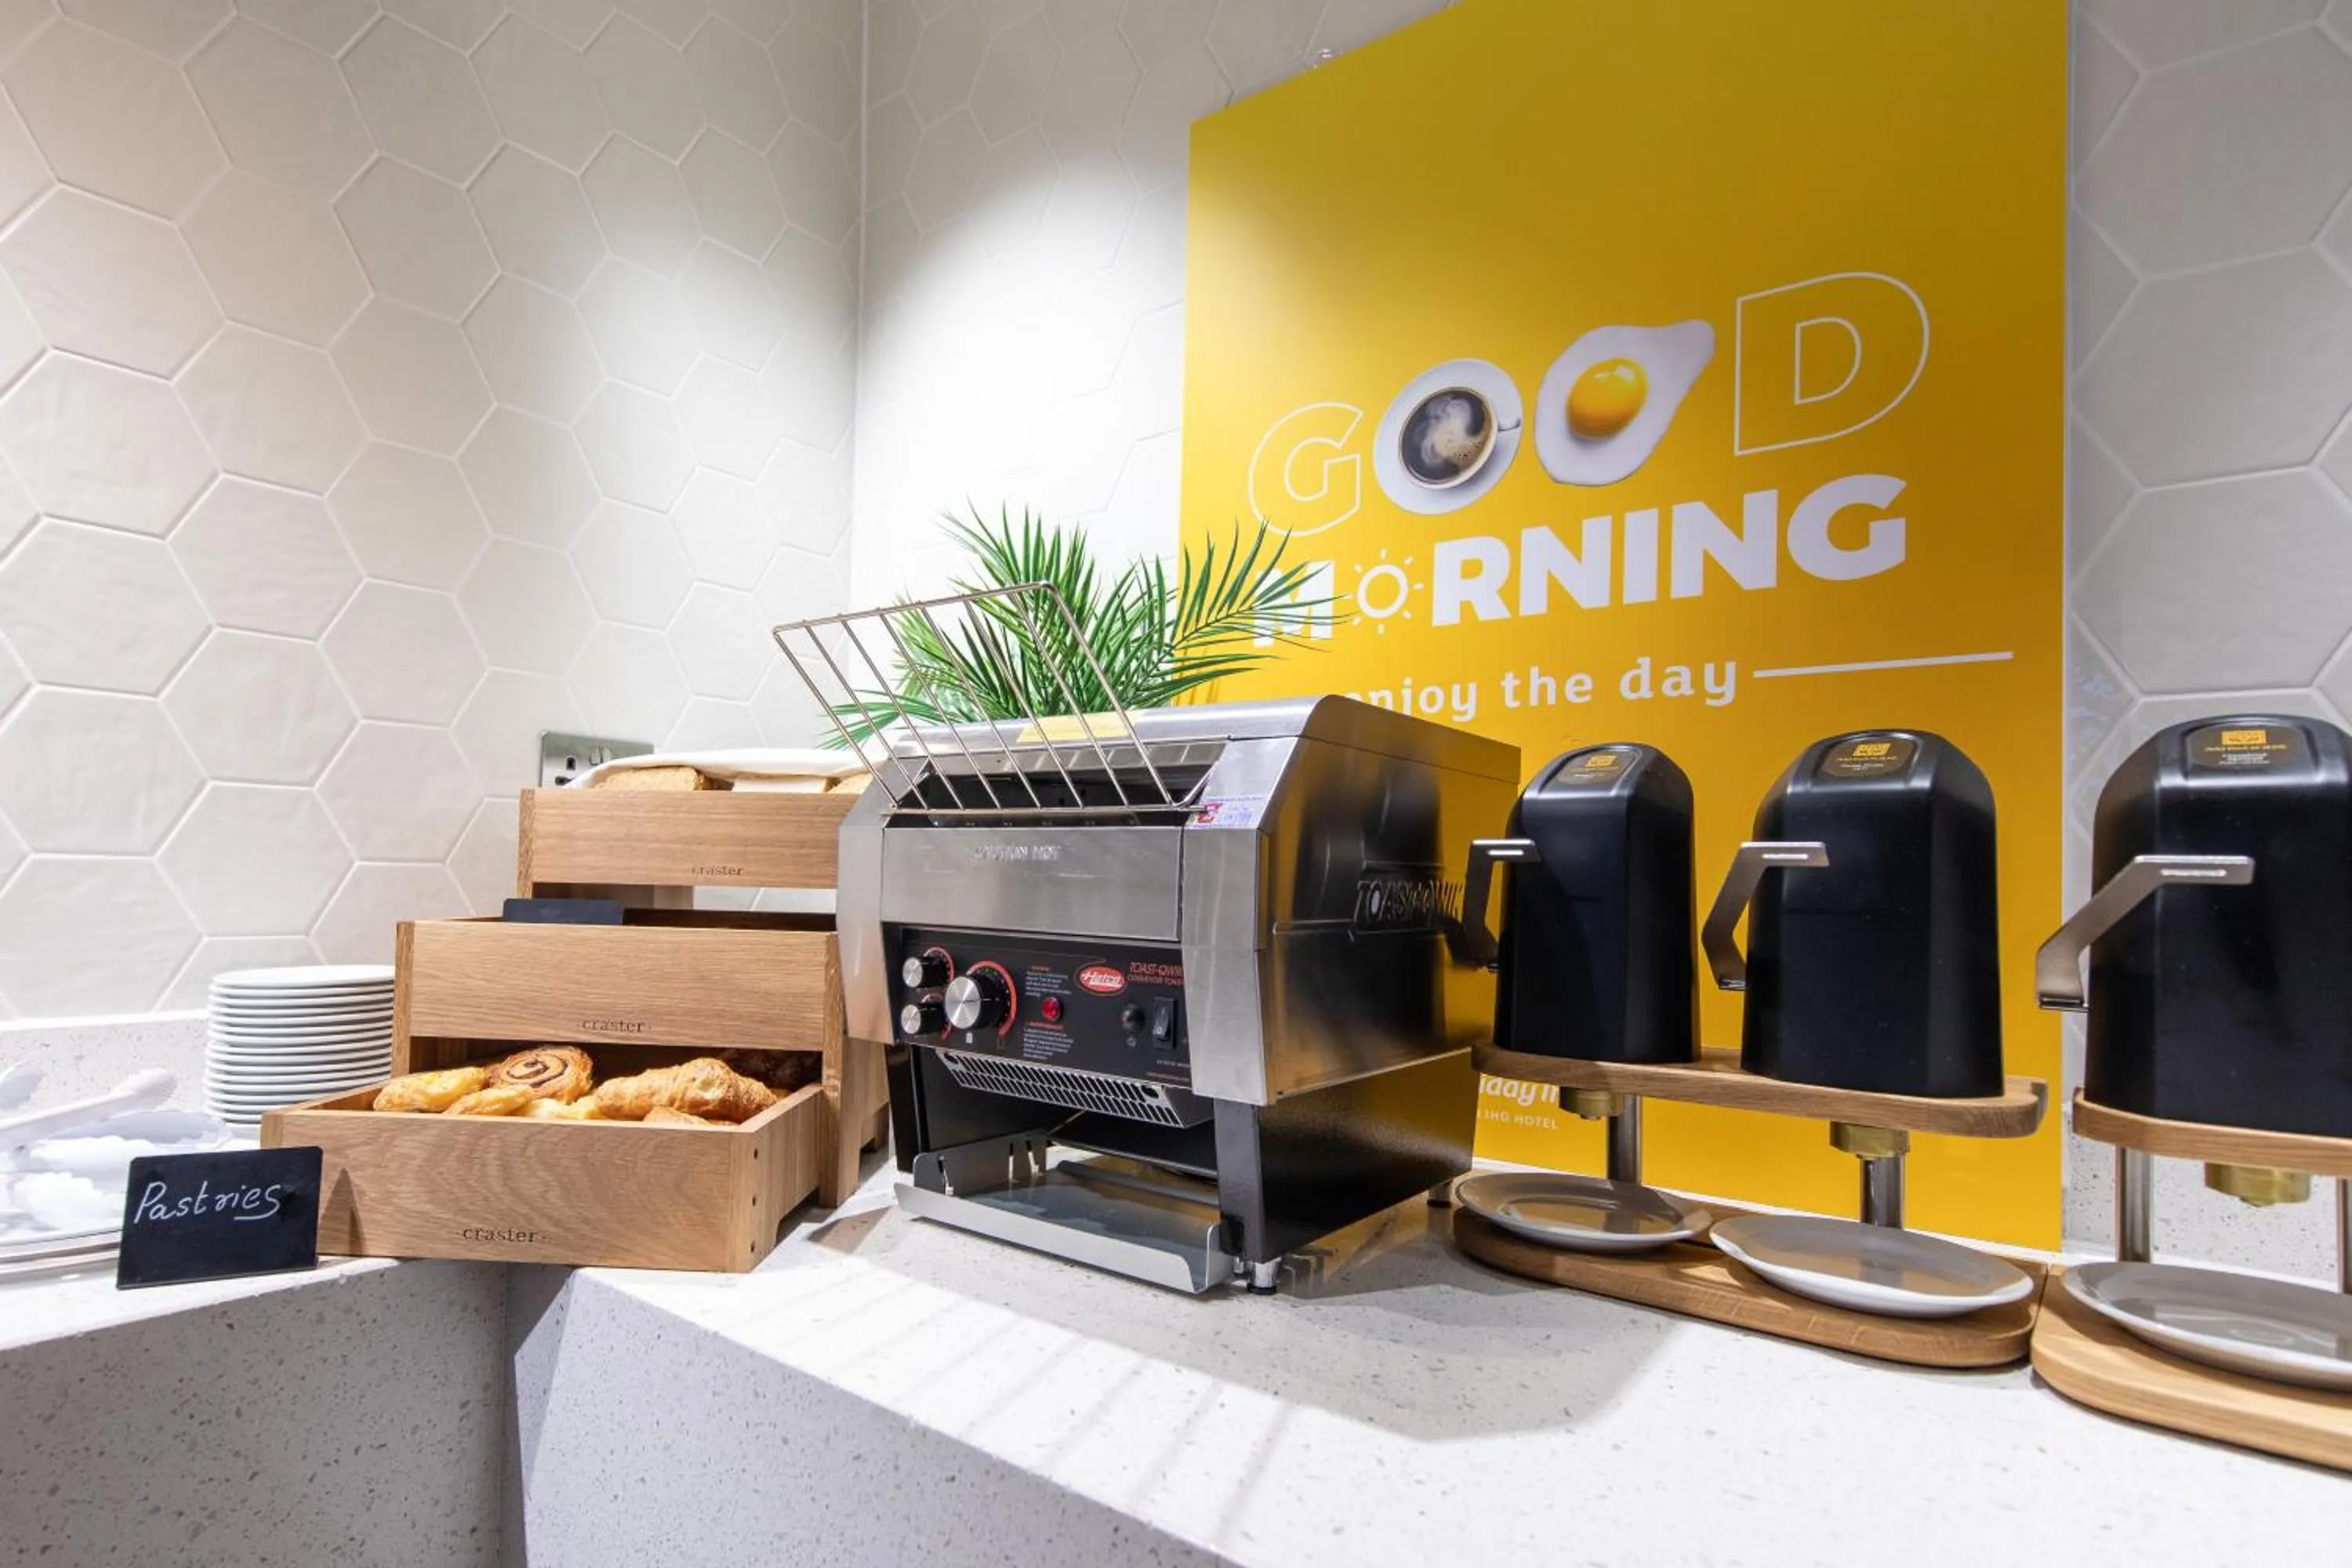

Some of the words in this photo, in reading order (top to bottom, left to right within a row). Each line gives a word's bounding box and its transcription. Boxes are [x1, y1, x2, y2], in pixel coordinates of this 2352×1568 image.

[1253, 472, 1907, 648] MORNING
[1500, 665, 1594, 708] the
[1619, 655, 1737, 707] day
[583, 1019, 646, 1033] craster
[1515, 1114, 1559, 1130] HOTEL
[132, 1180, 281, 1225] Pastries
[463, 1228, 538, 1243] craster
